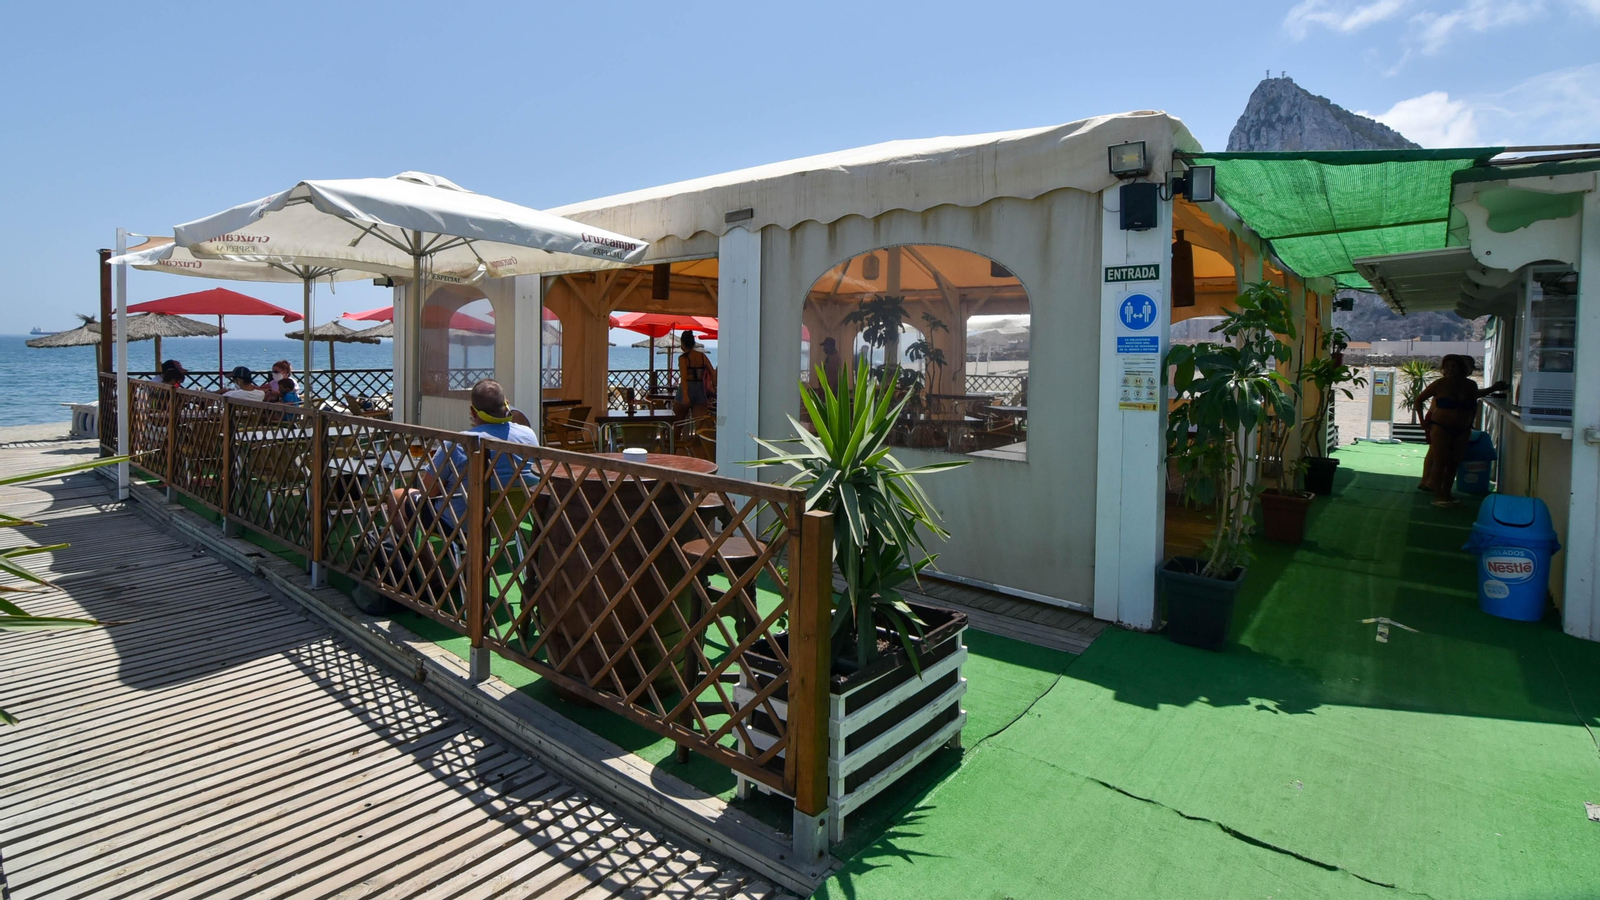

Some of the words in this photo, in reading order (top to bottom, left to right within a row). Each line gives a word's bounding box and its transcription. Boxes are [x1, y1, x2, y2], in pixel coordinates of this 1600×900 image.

[581, 232, 636, 251] Cruzcampo
[432, 273, 462, 283] ESPECIAL
[1107, 266, 1156, 281] ENTRADA
[1487, 561, 1532, 574] Nestlé
